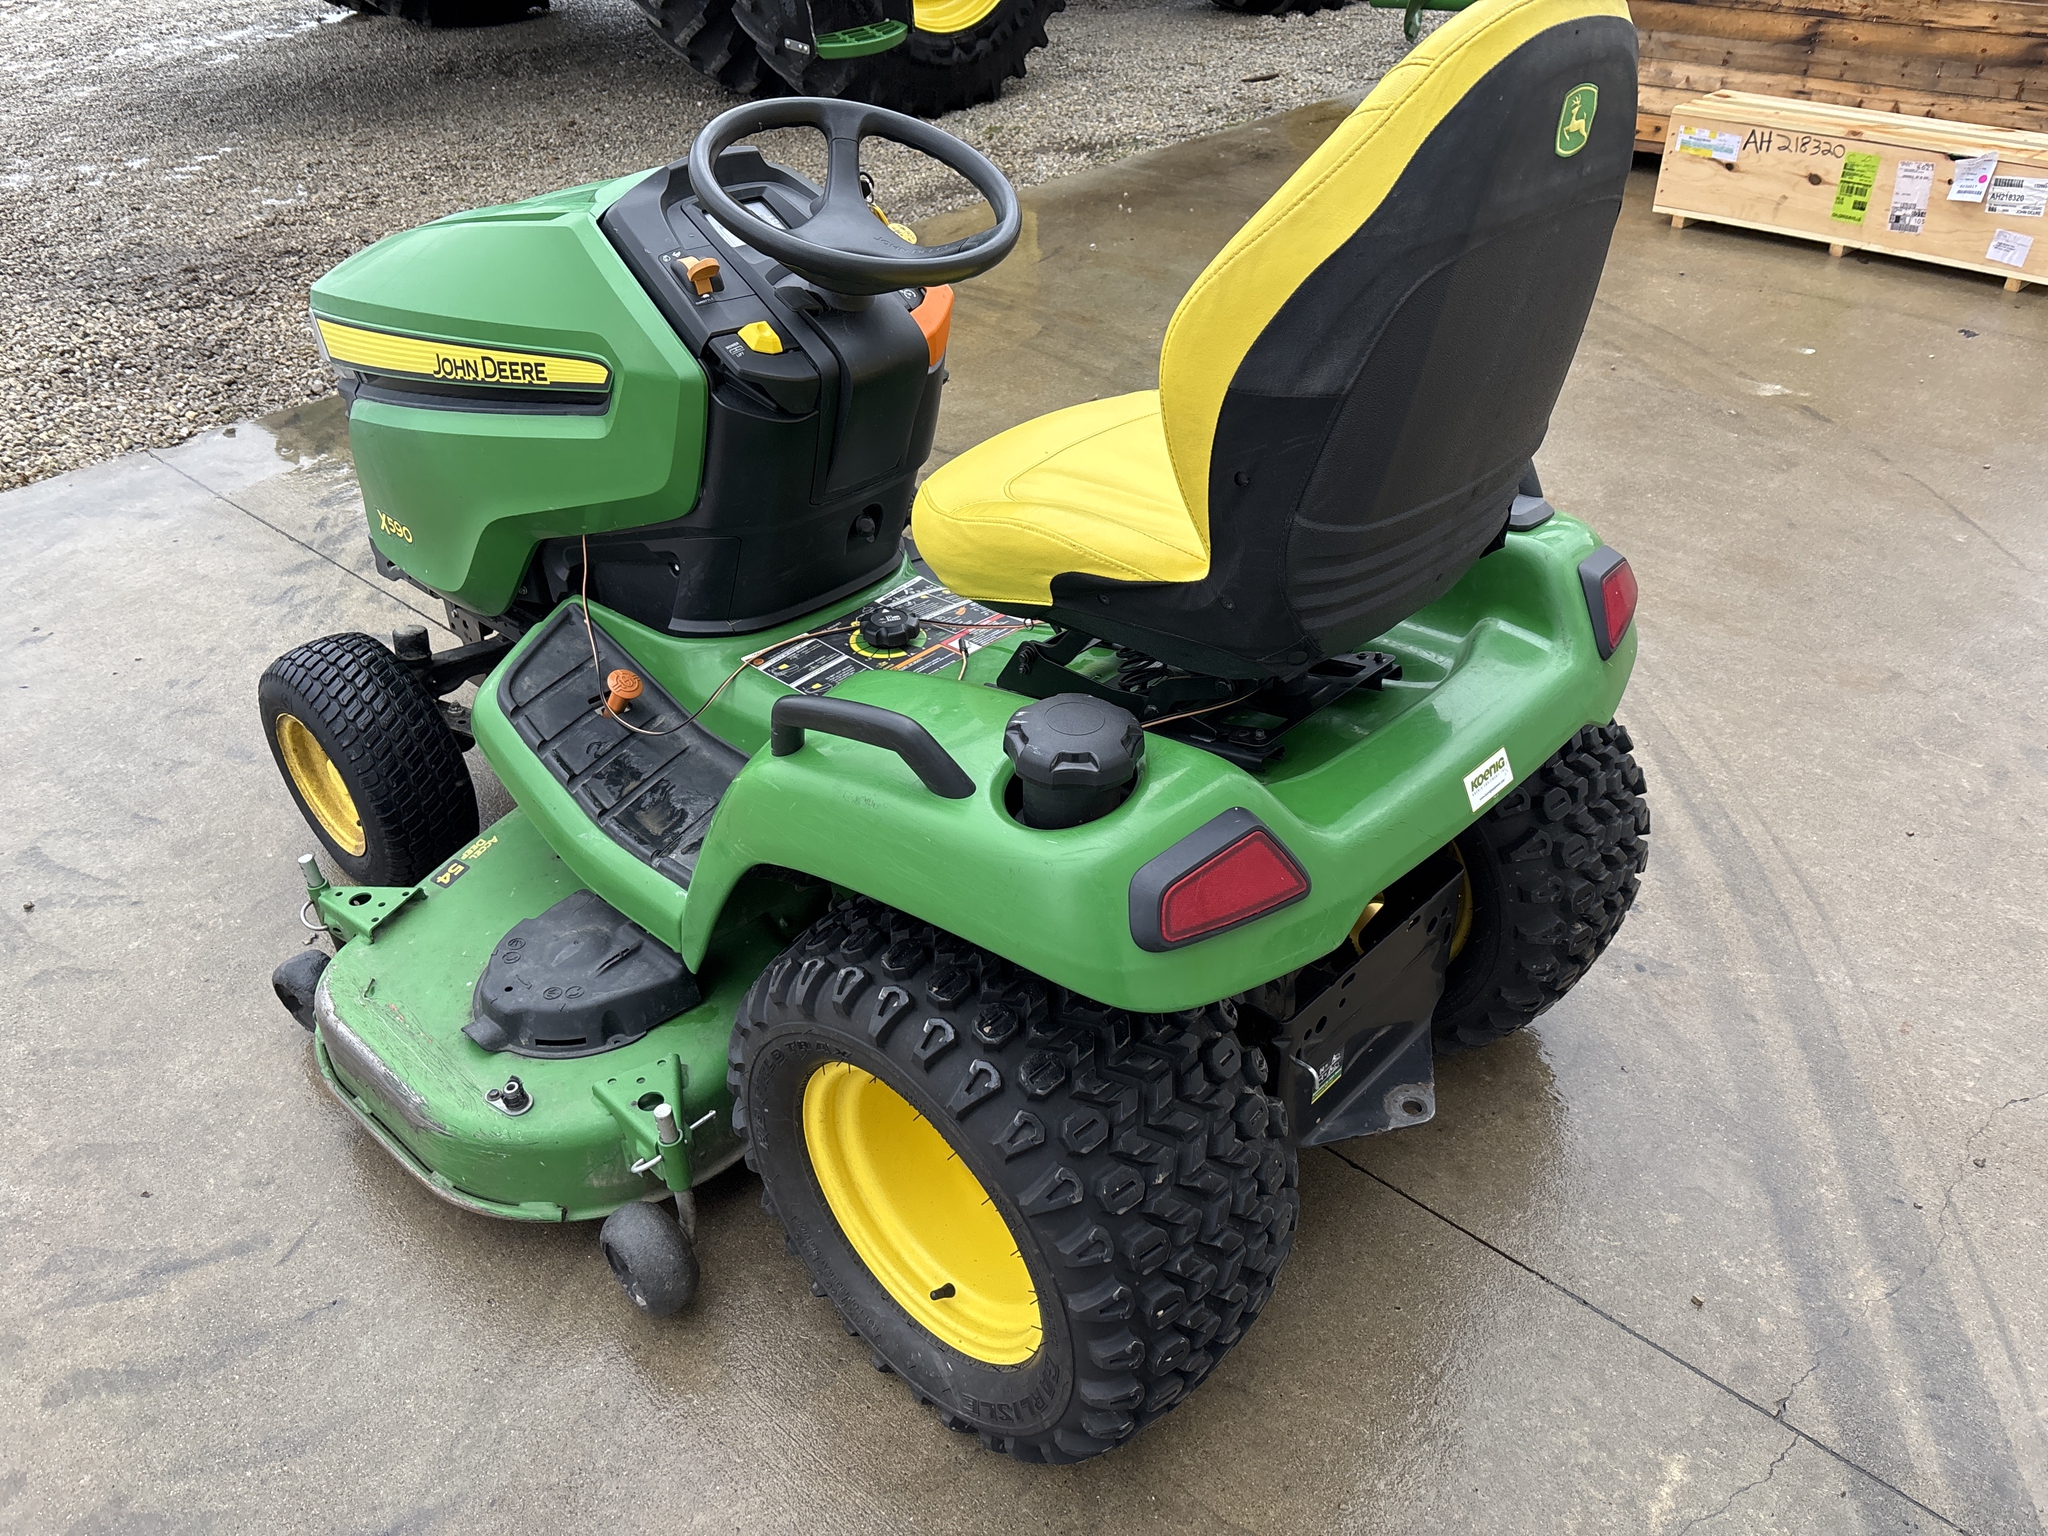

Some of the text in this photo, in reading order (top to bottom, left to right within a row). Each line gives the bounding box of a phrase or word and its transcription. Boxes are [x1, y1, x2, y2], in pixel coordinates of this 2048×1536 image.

[1990, 192, 2025, 203] AH218320
[433, 353, 548, 382] JOHN DEERE
[376, 508, 414, 544] X590
[460, 838, 487, 860] DEEP
[468, 835, 498, 860] ACCEL
[436, 862, 465, 885] 54
[784, 1039, 853, 1059] TRAX
[962, 1352, 1061, 1424] CARLISLE
